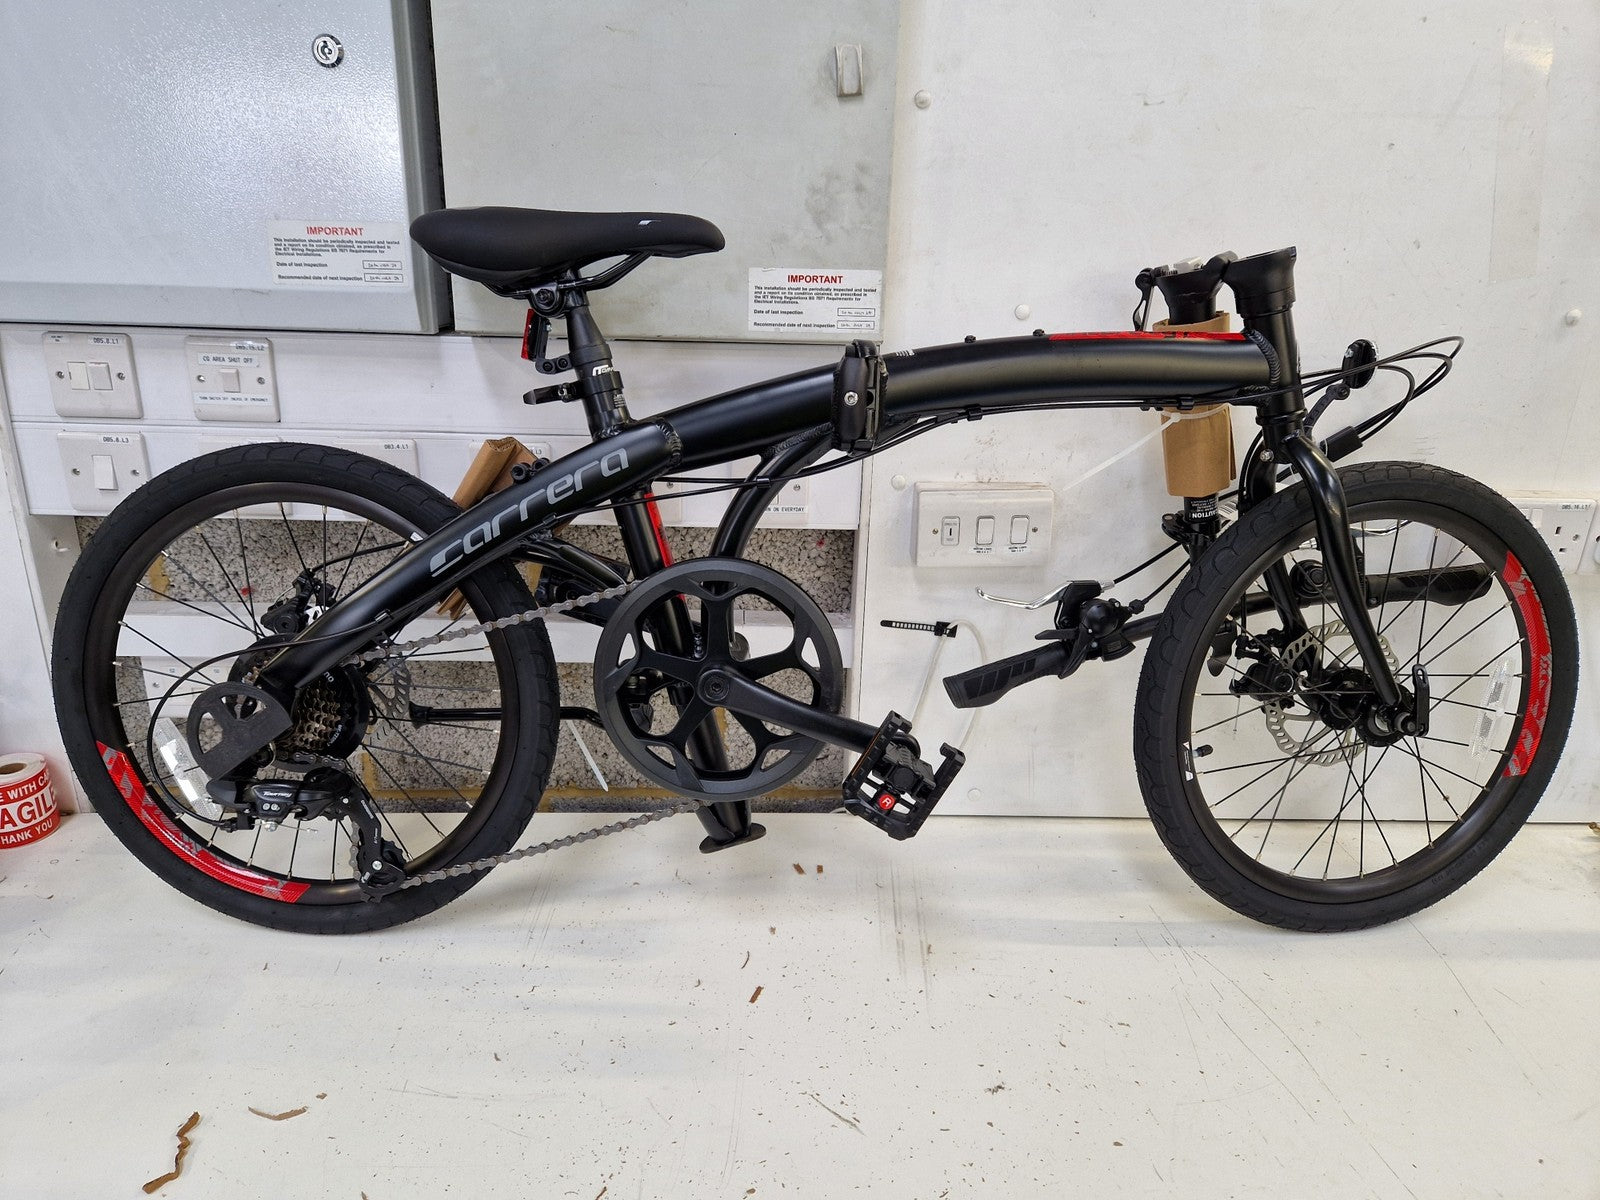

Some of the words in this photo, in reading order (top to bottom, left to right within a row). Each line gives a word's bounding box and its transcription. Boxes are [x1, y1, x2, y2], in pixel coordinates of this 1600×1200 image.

[306, 226, 364, 236] IMPORTANT
[788, 275, 844, 284] IMPORTANT
[430, 448, 630, 578] carrera
[1192, 510, 1218, 518] AUTION
[7, 781, 37, 800] WITH
[38, 769, 50, 786] CA
[0, 785, 57, 830] AGILE
[882, 797, 892, 807] R
[1, 830, 32, 844] HANK
[35, 818, 53, 835] YOU
